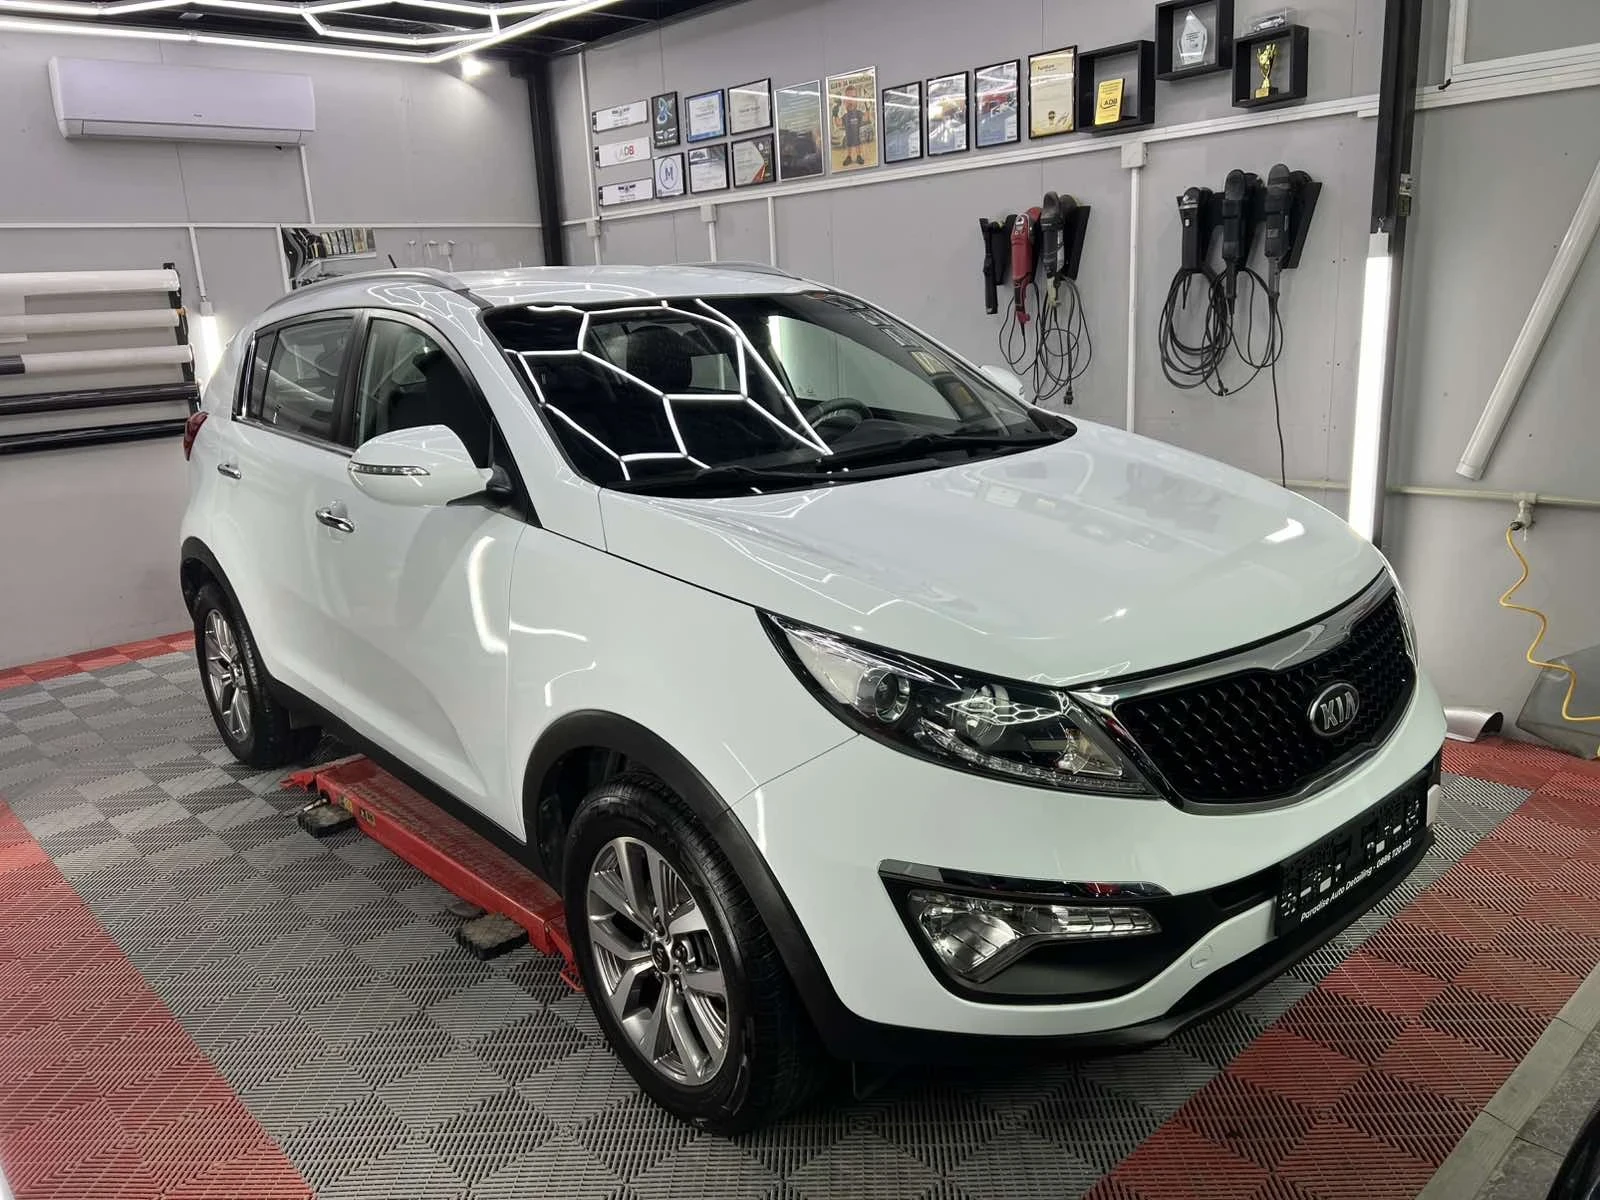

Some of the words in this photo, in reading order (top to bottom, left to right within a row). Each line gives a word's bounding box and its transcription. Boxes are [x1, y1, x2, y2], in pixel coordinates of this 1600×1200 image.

[1319, 691, 1356, 730] KIA
[1300, 897, 1330, 923] Paradise
[1329, 887, 1345, 903] Auto
[1345, 866, 1373, 891] Detailing
